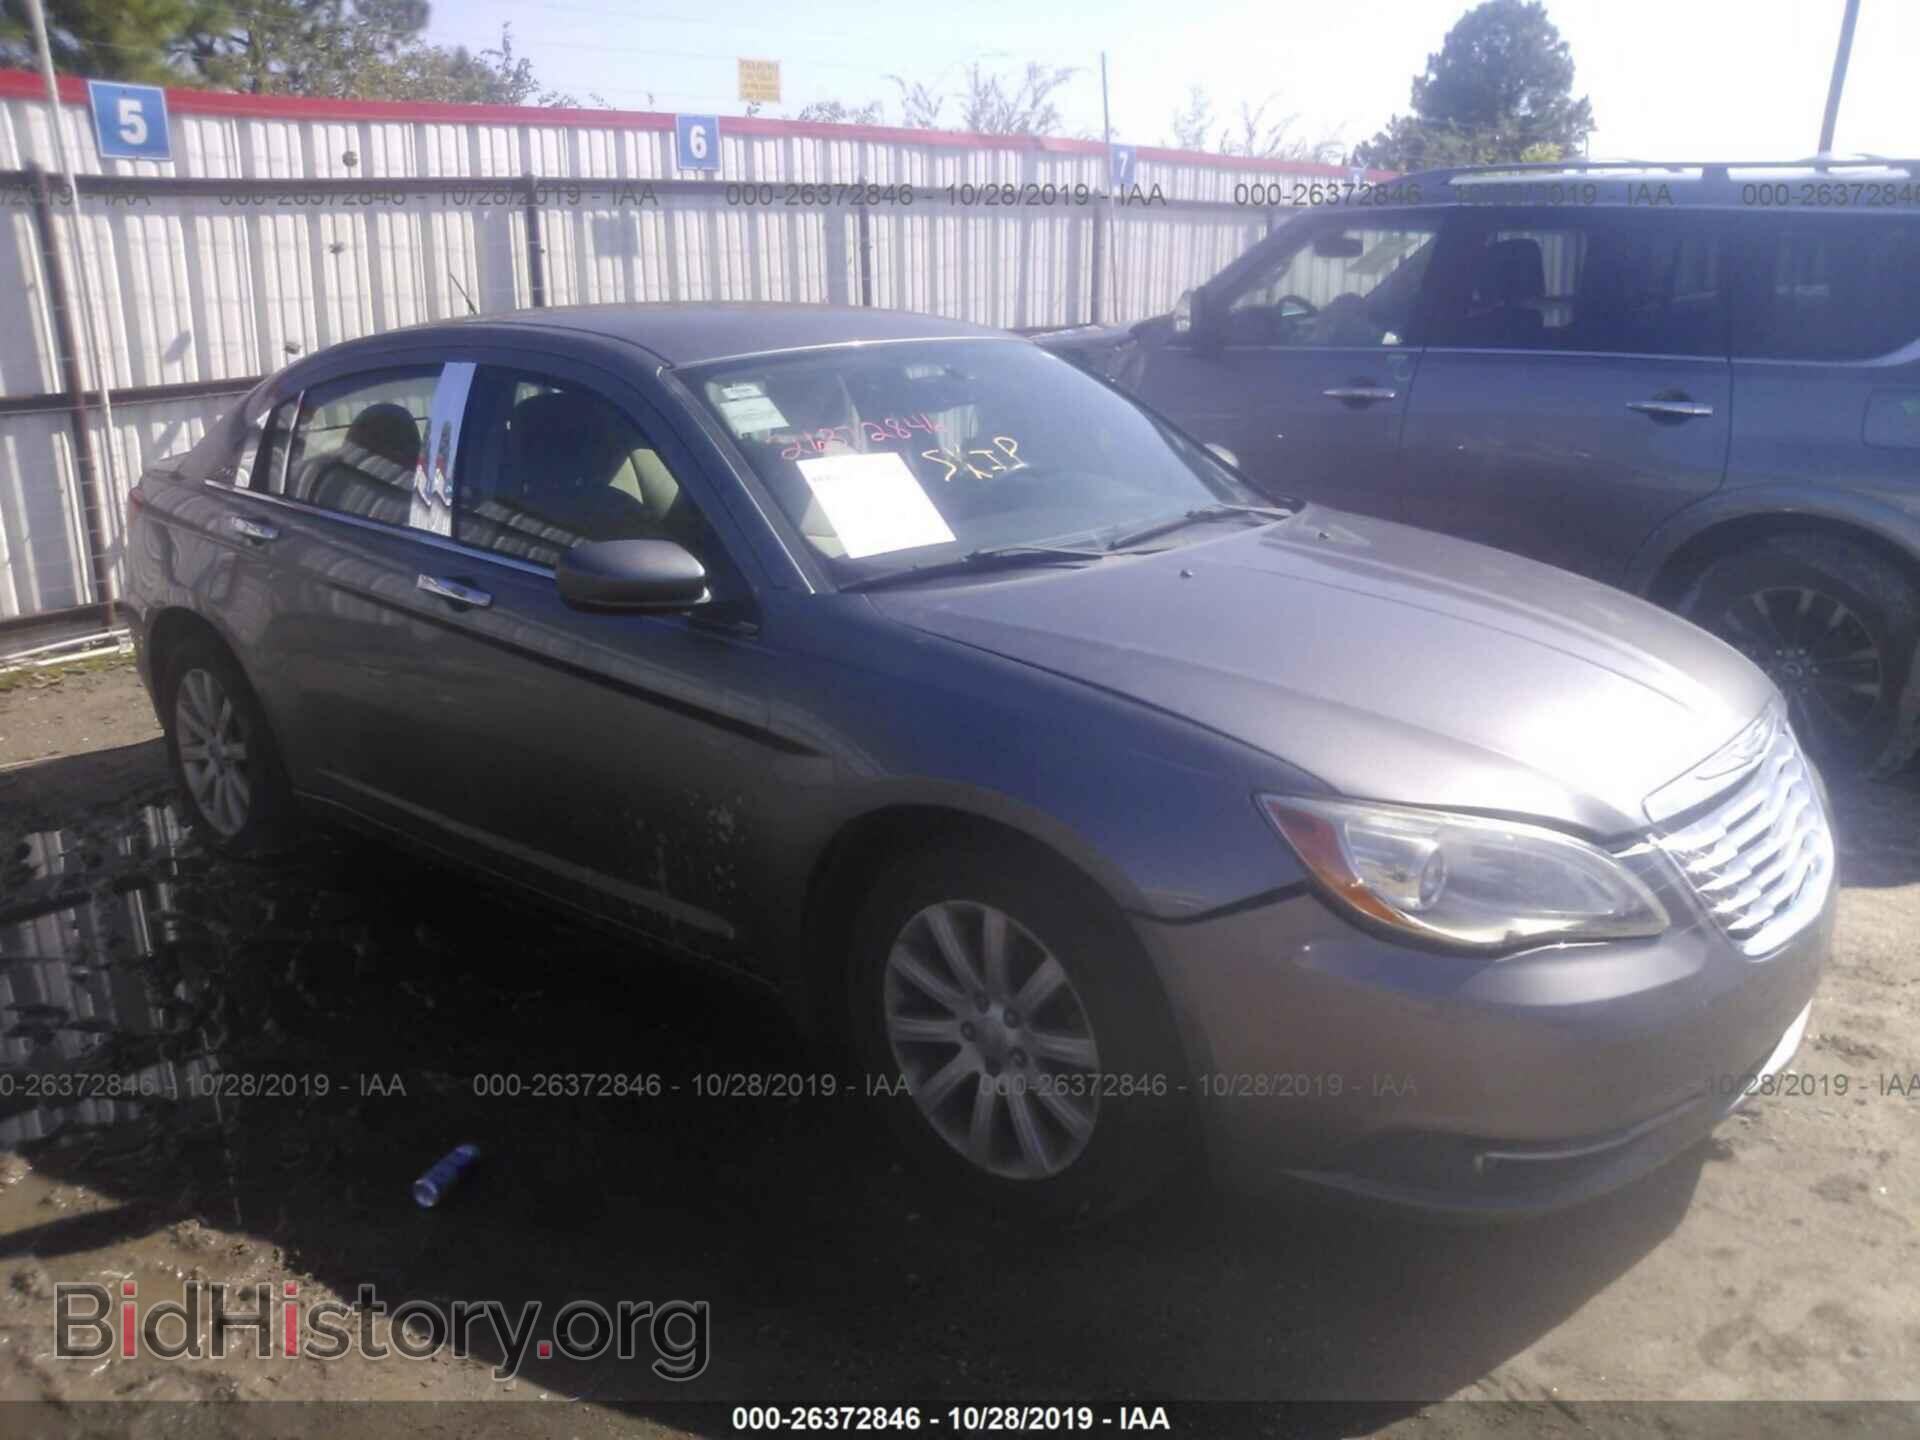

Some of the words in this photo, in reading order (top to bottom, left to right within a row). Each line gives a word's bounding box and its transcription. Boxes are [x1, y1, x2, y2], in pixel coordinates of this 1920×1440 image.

[118, 99, 147, 144] 5
[690, 125, 707, 159] 6
[1119, 151, 1129, 177] 7
[921, 436, 1028, 481] SKIP
